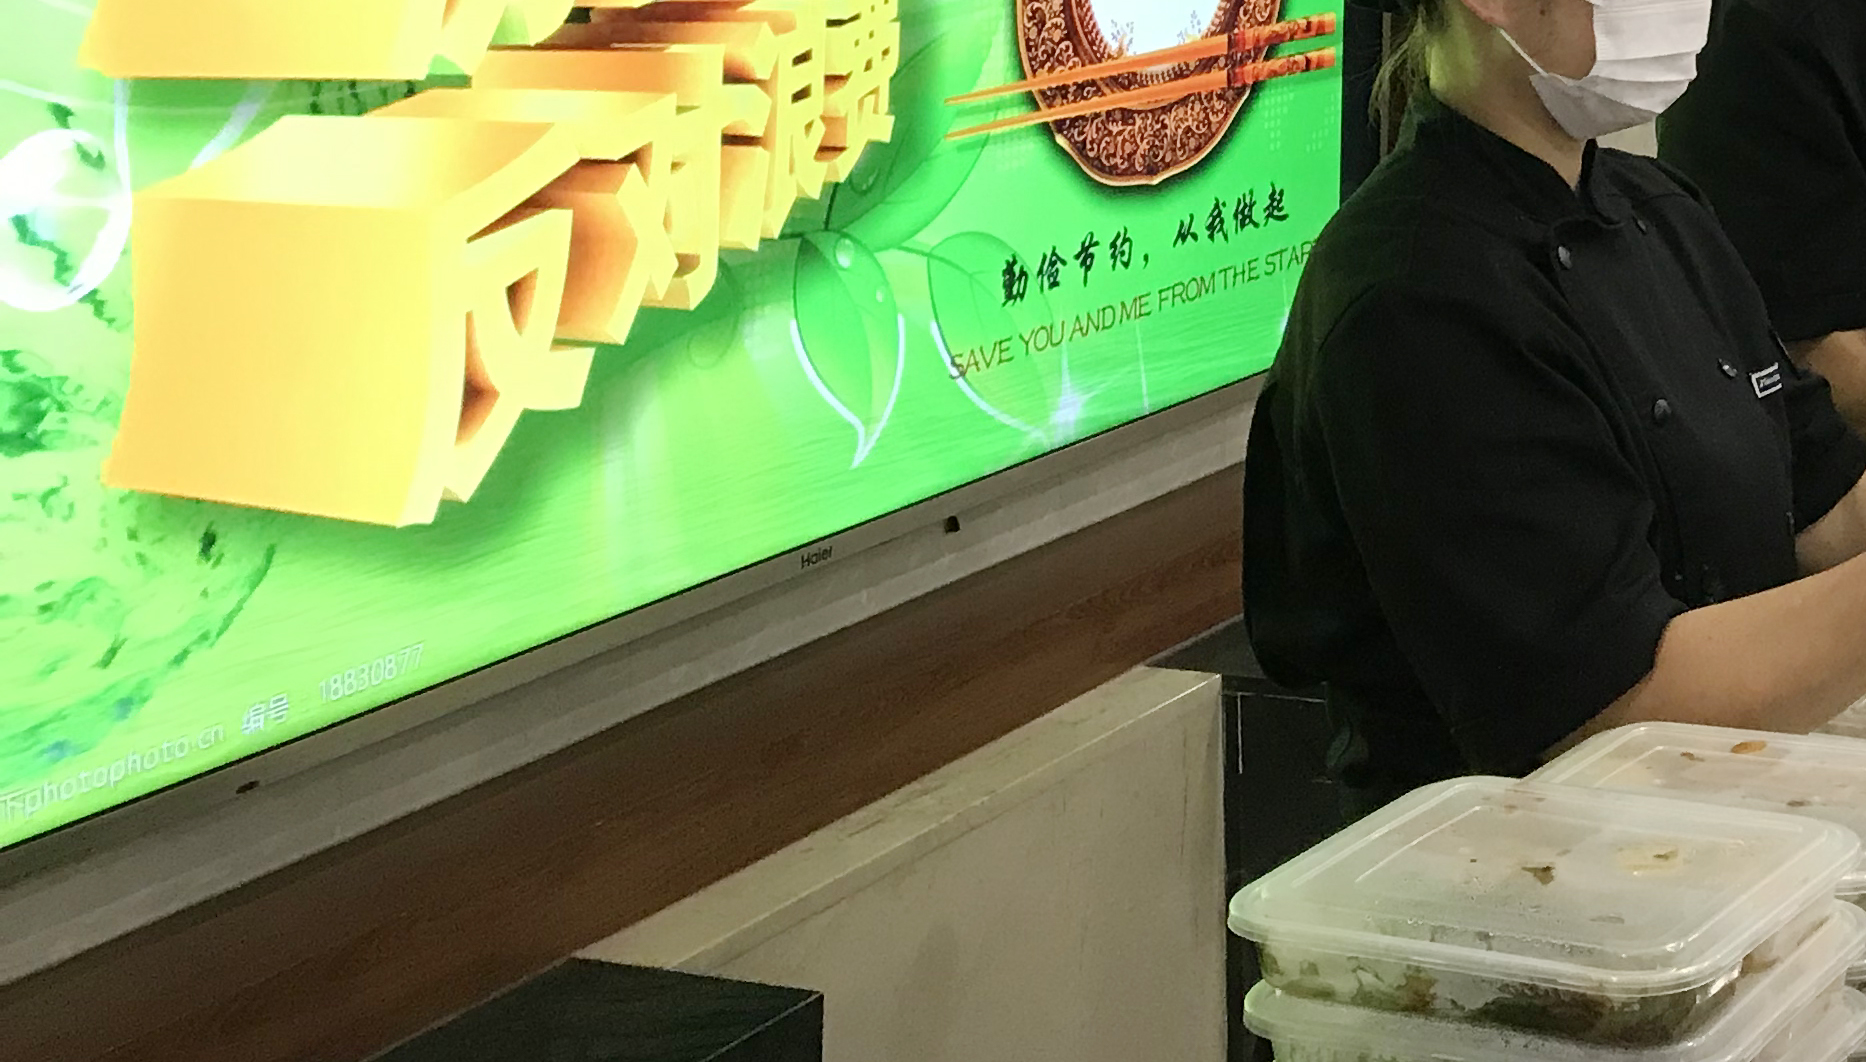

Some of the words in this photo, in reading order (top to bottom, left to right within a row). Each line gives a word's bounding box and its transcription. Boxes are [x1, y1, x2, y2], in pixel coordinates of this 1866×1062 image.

[949, 335, 1014, 379] SAVE
[1019, 320, 1066, 356] YOU
[1069, 304, 1116, 342] AND
[1119, 292, 1152, 325] ME
[1157, 273, 1216, 312] FROM
[1218, 257, 1260, 290] THE
[1263, 238, 1318, 276] STAR
[801, 546, 832, 569] Haier
[241, 693, 289, 735] 编号
[318, 642, 425, 703] 18830877
